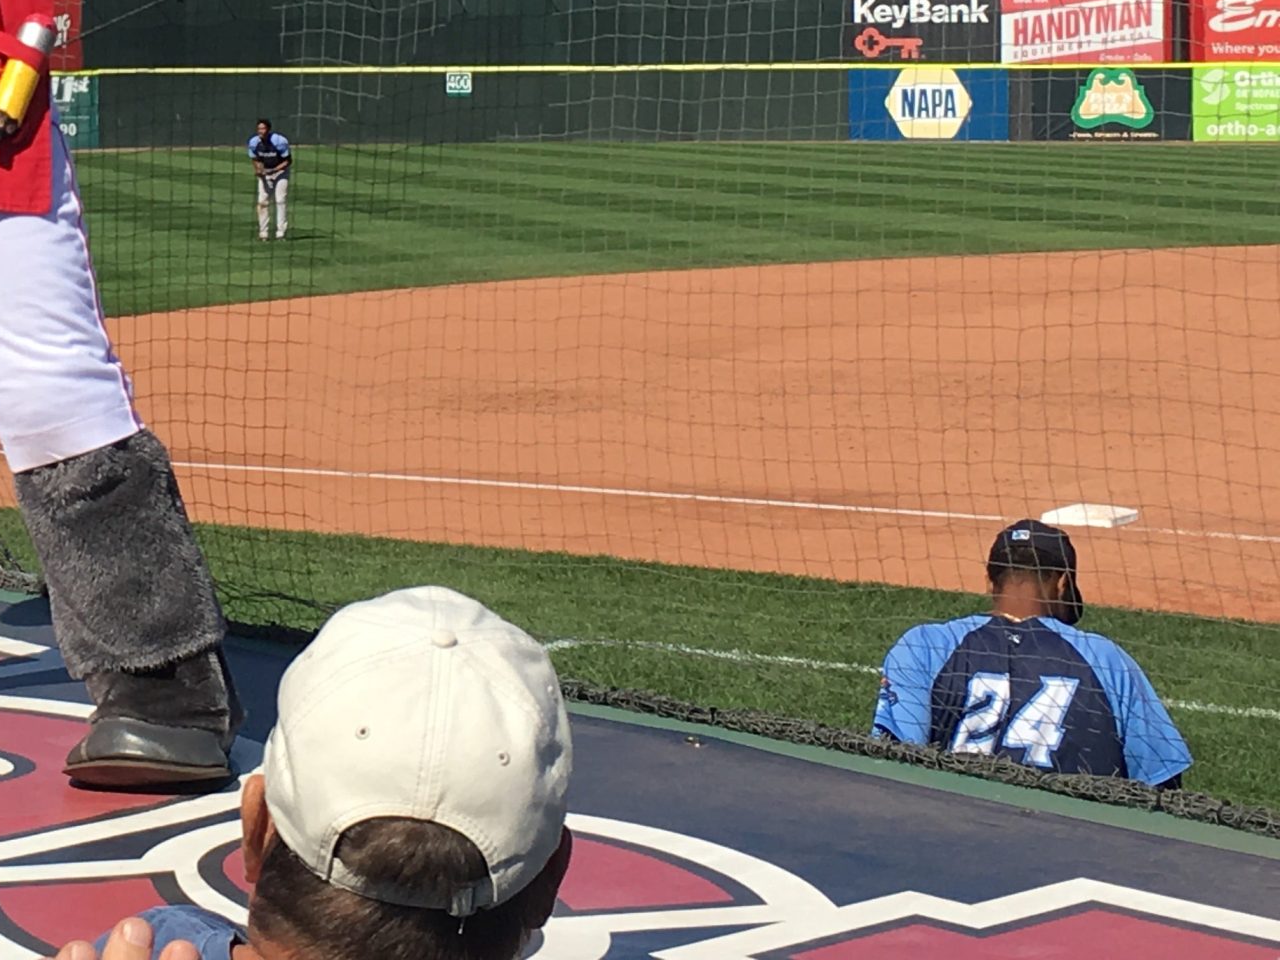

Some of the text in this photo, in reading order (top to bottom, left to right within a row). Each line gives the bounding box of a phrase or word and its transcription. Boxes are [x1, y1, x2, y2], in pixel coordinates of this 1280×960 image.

[1013, 40, 1093, 59] EQUIPMENT
[1211, 42, 1255, 54] Where
[900, 88, 957, 119] NAPA
[950, 671, 1080, 769] 24
